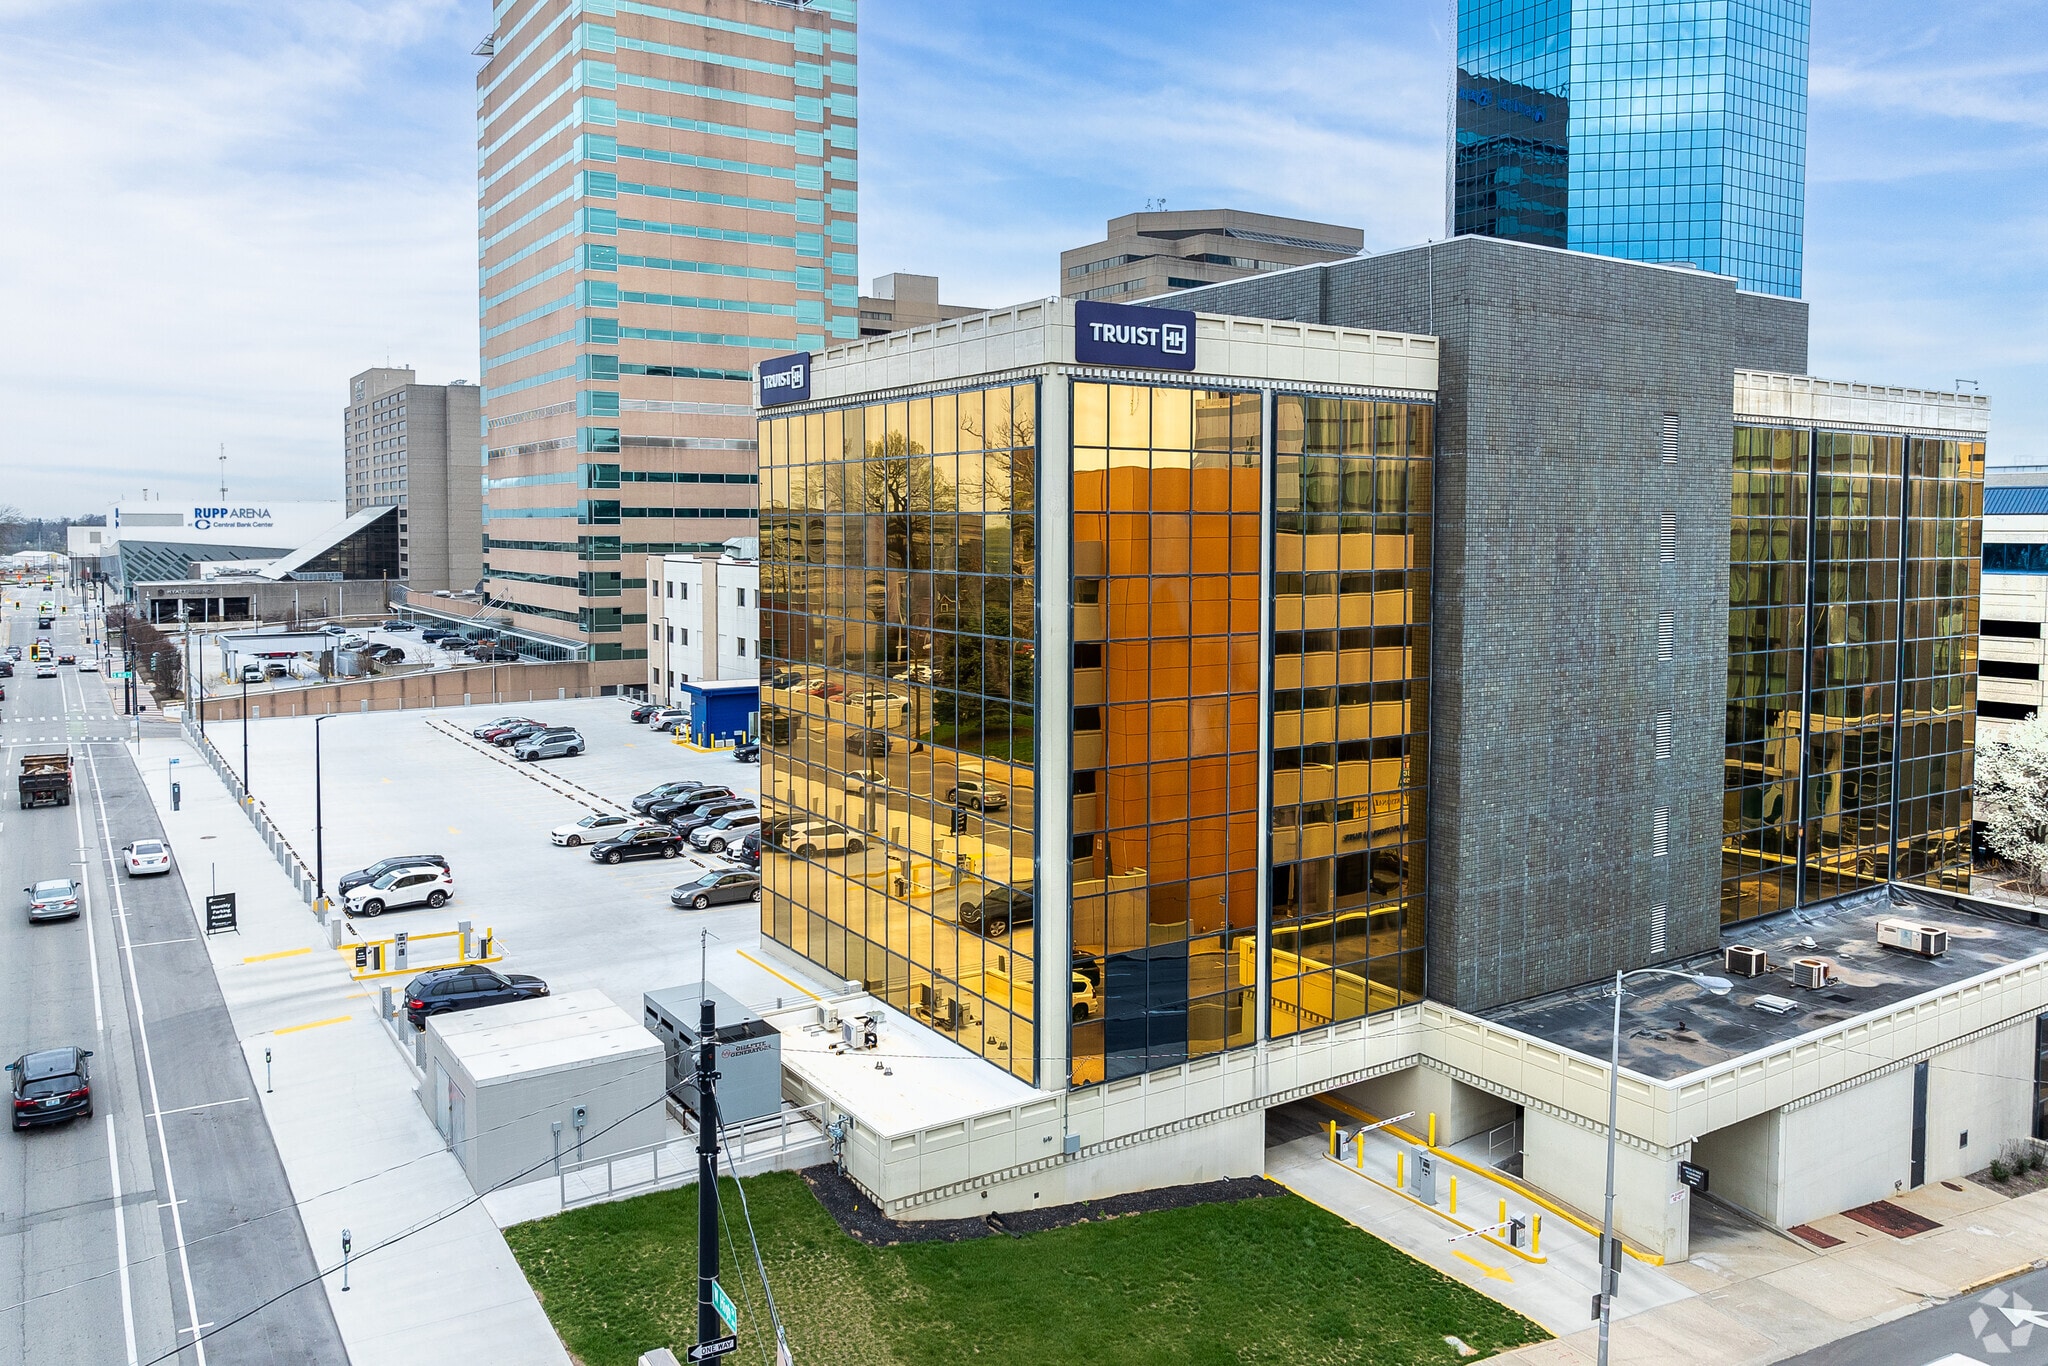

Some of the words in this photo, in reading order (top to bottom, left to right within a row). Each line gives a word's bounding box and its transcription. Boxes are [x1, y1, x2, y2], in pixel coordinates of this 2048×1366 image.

[1089, 322, 1160, 346] TRUIST
[762, 371, 791, 389] TRUIST
[194, 507, 228, 518] RUPP
[229, 508, 271, 518] ARENA
[701, 1345, 717, 1355] ONE
[717, 1340, 732, 1351] WAY
